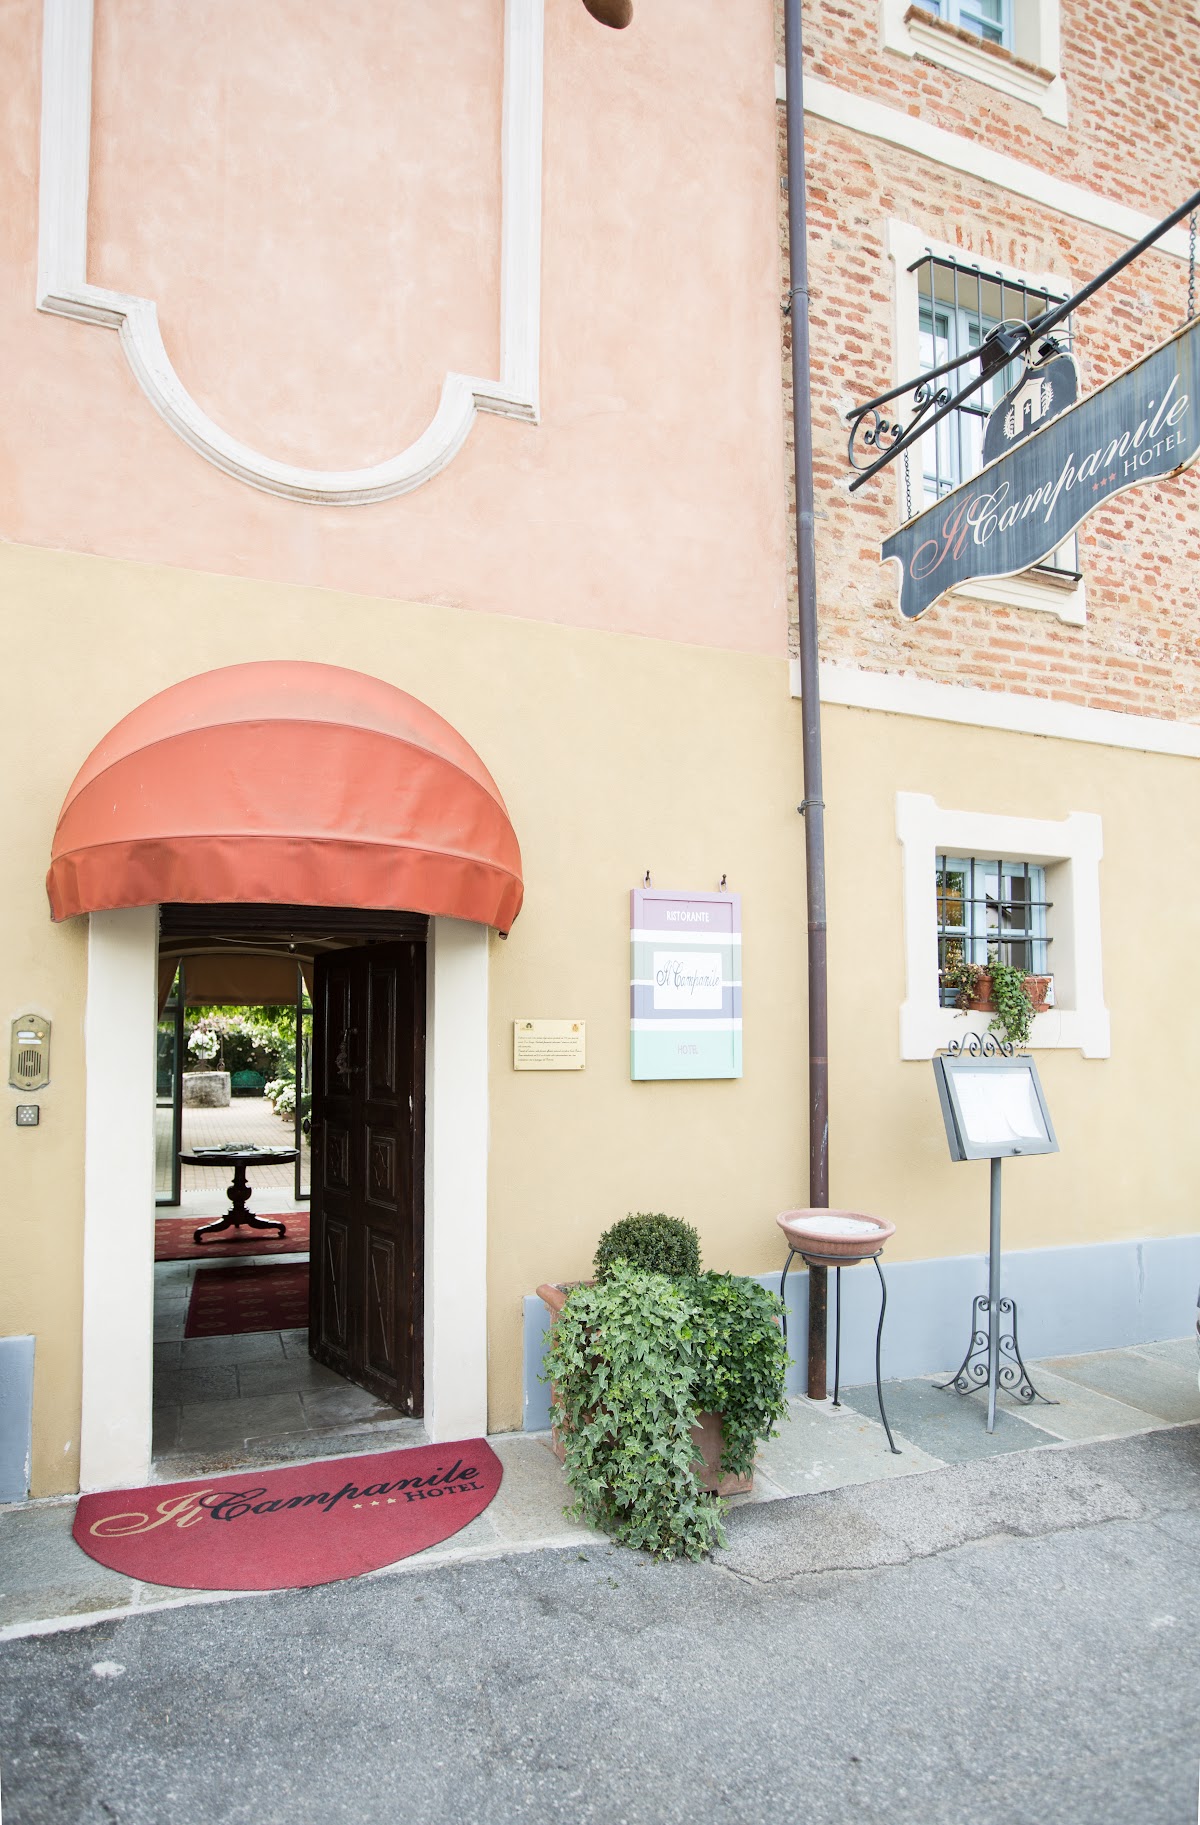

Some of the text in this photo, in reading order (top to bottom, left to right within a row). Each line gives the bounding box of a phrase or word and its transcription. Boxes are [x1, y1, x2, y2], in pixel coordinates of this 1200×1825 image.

[1123, 430, 1187, 477] HOTEL
[910, 373, 1190, 580] Il Campanile
[666, 911, 710, 922] RISTORANTE
[656, 960, 720, 995] Il Campanile
[677, 1045, 699, 1055] HOTEL
[89, 1460, 481, 1538] Il Campanile
[405, 1480, 486, 1502] HOTEL
